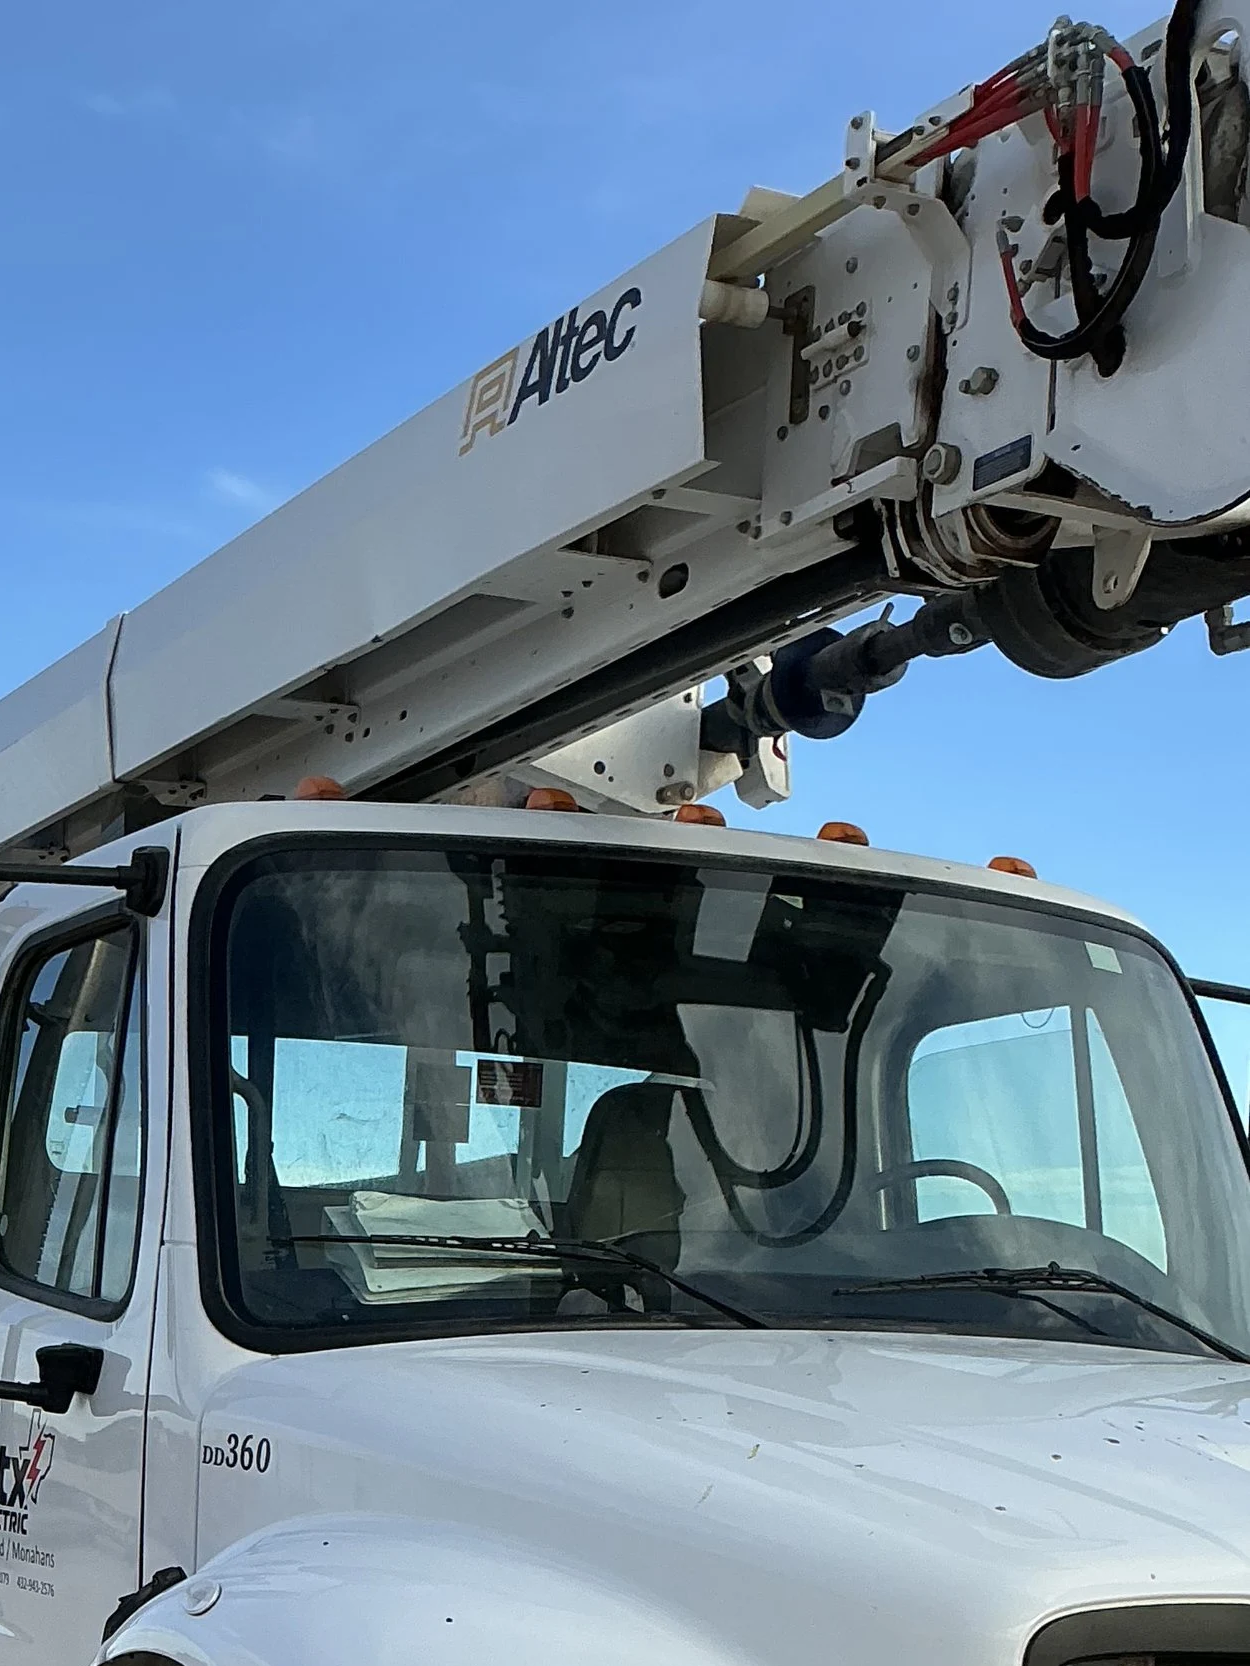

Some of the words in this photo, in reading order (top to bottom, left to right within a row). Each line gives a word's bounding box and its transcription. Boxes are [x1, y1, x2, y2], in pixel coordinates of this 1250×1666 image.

[506, 287, 642, 426] Altec
[202, 1433, 271, 1473] DD360
[12, 1541, 55, 1568] Monahans
